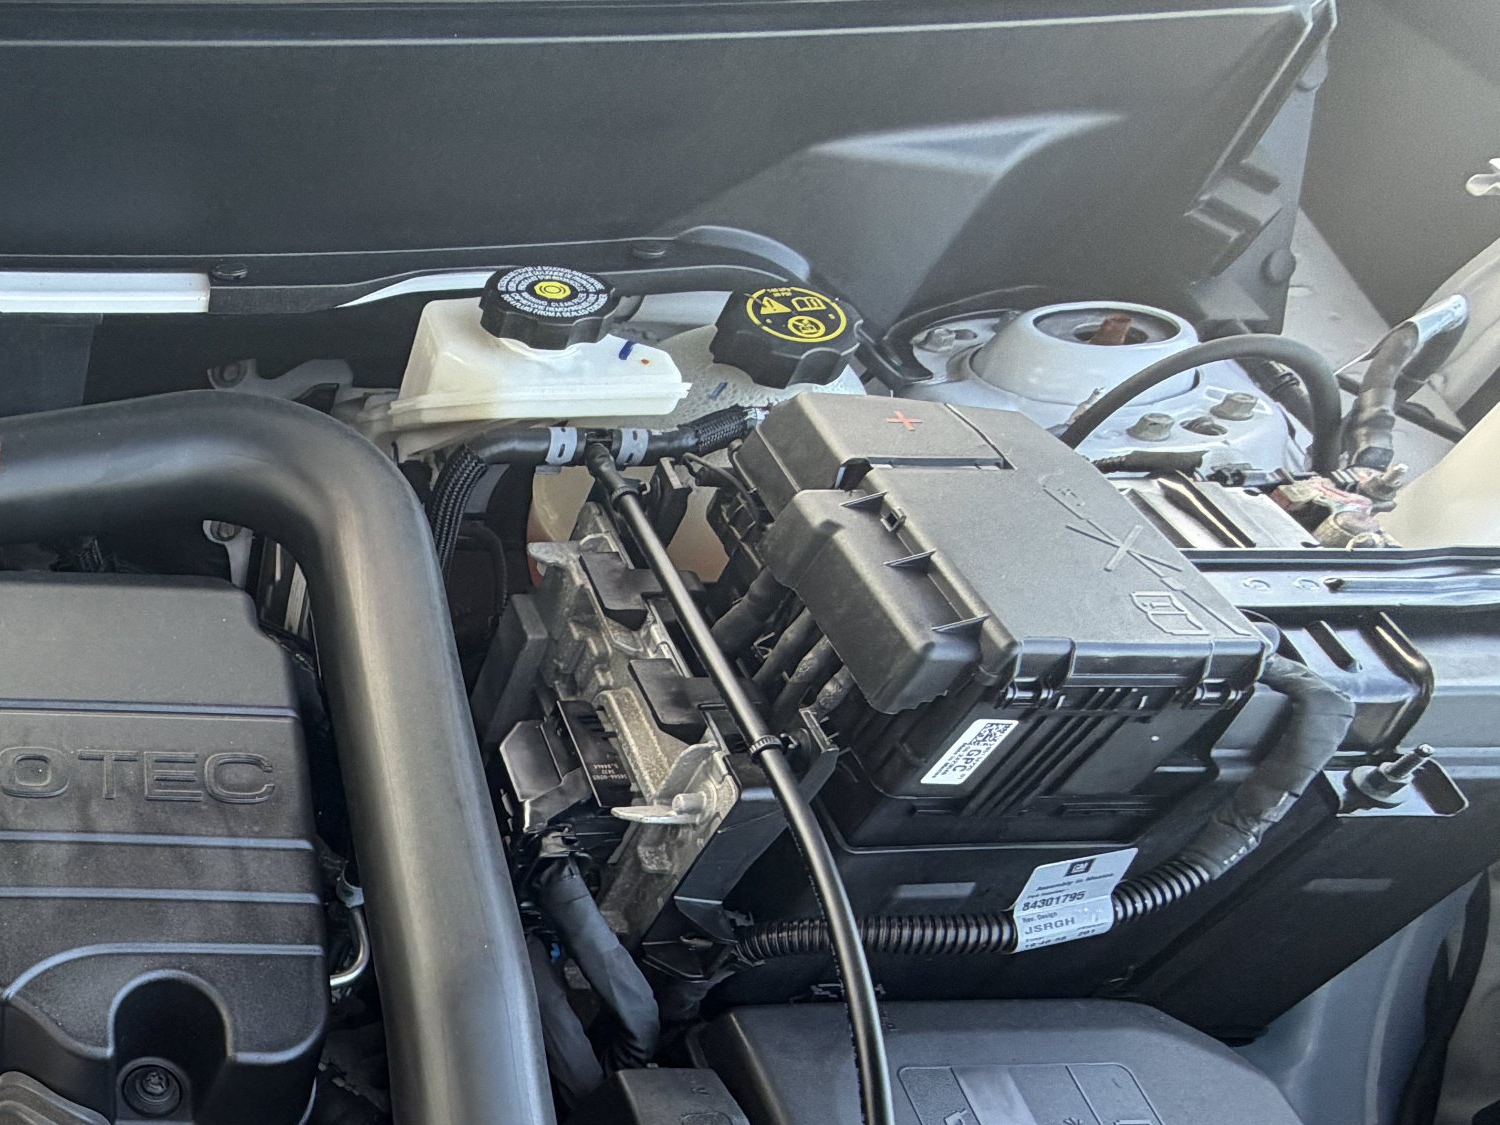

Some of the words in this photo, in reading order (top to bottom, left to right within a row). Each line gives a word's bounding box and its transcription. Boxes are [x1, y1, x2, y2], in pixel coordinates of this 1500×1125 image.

[952, 748, 982, 773] GPC
[1022, 890, 1087, 912] 84301795
[1024, 917, 1075, 935] JSRGH
